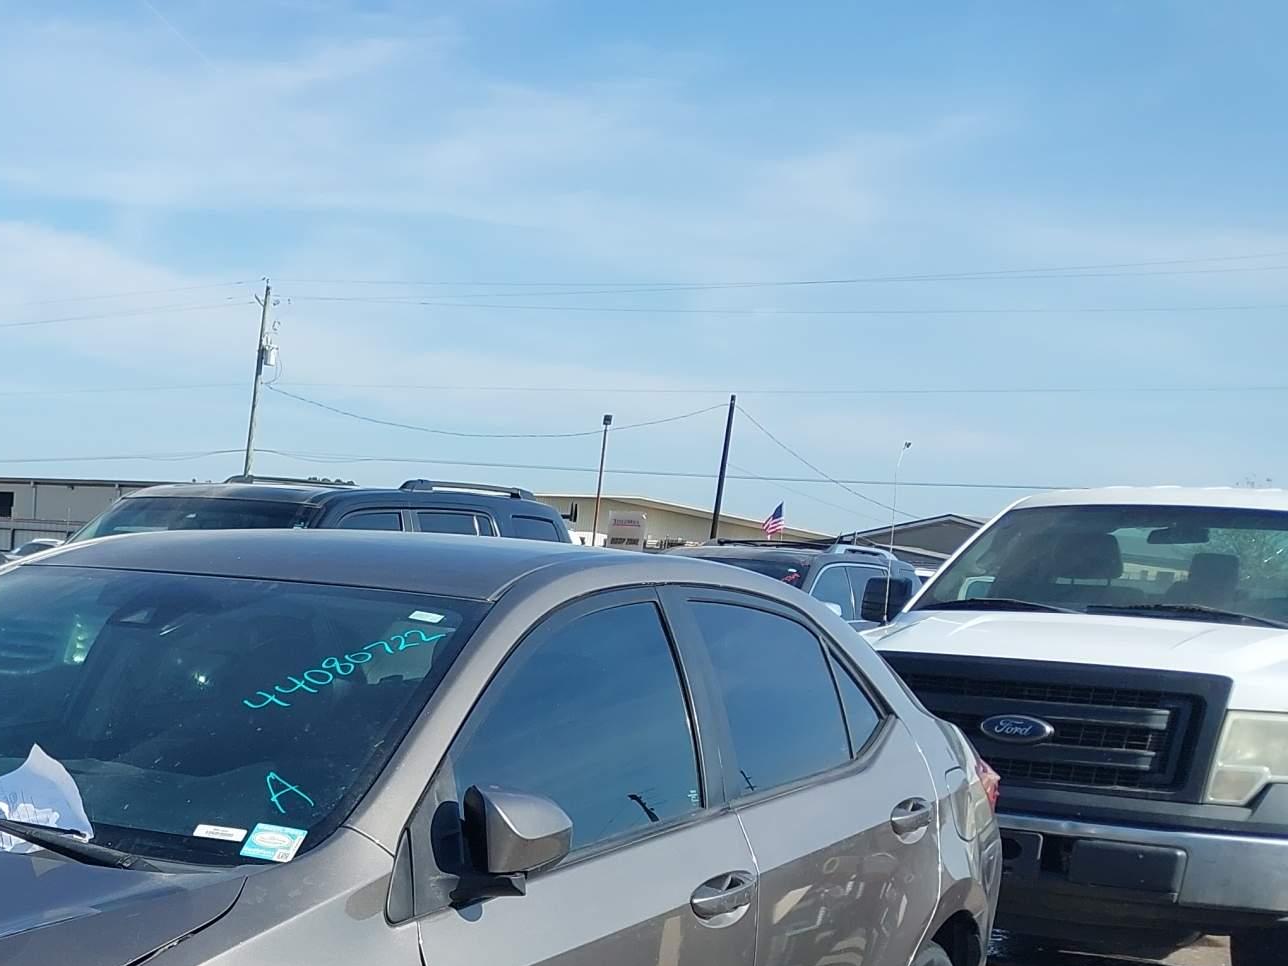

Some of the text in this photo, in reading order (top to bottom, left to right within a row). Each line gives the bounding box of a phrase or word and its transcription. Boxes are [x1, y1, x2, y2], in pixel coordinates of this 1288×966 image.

[243, 629, 447, 709] 44080722
[994, 719, 1033, 737] Ford
[266, 771, 314, 813] A
